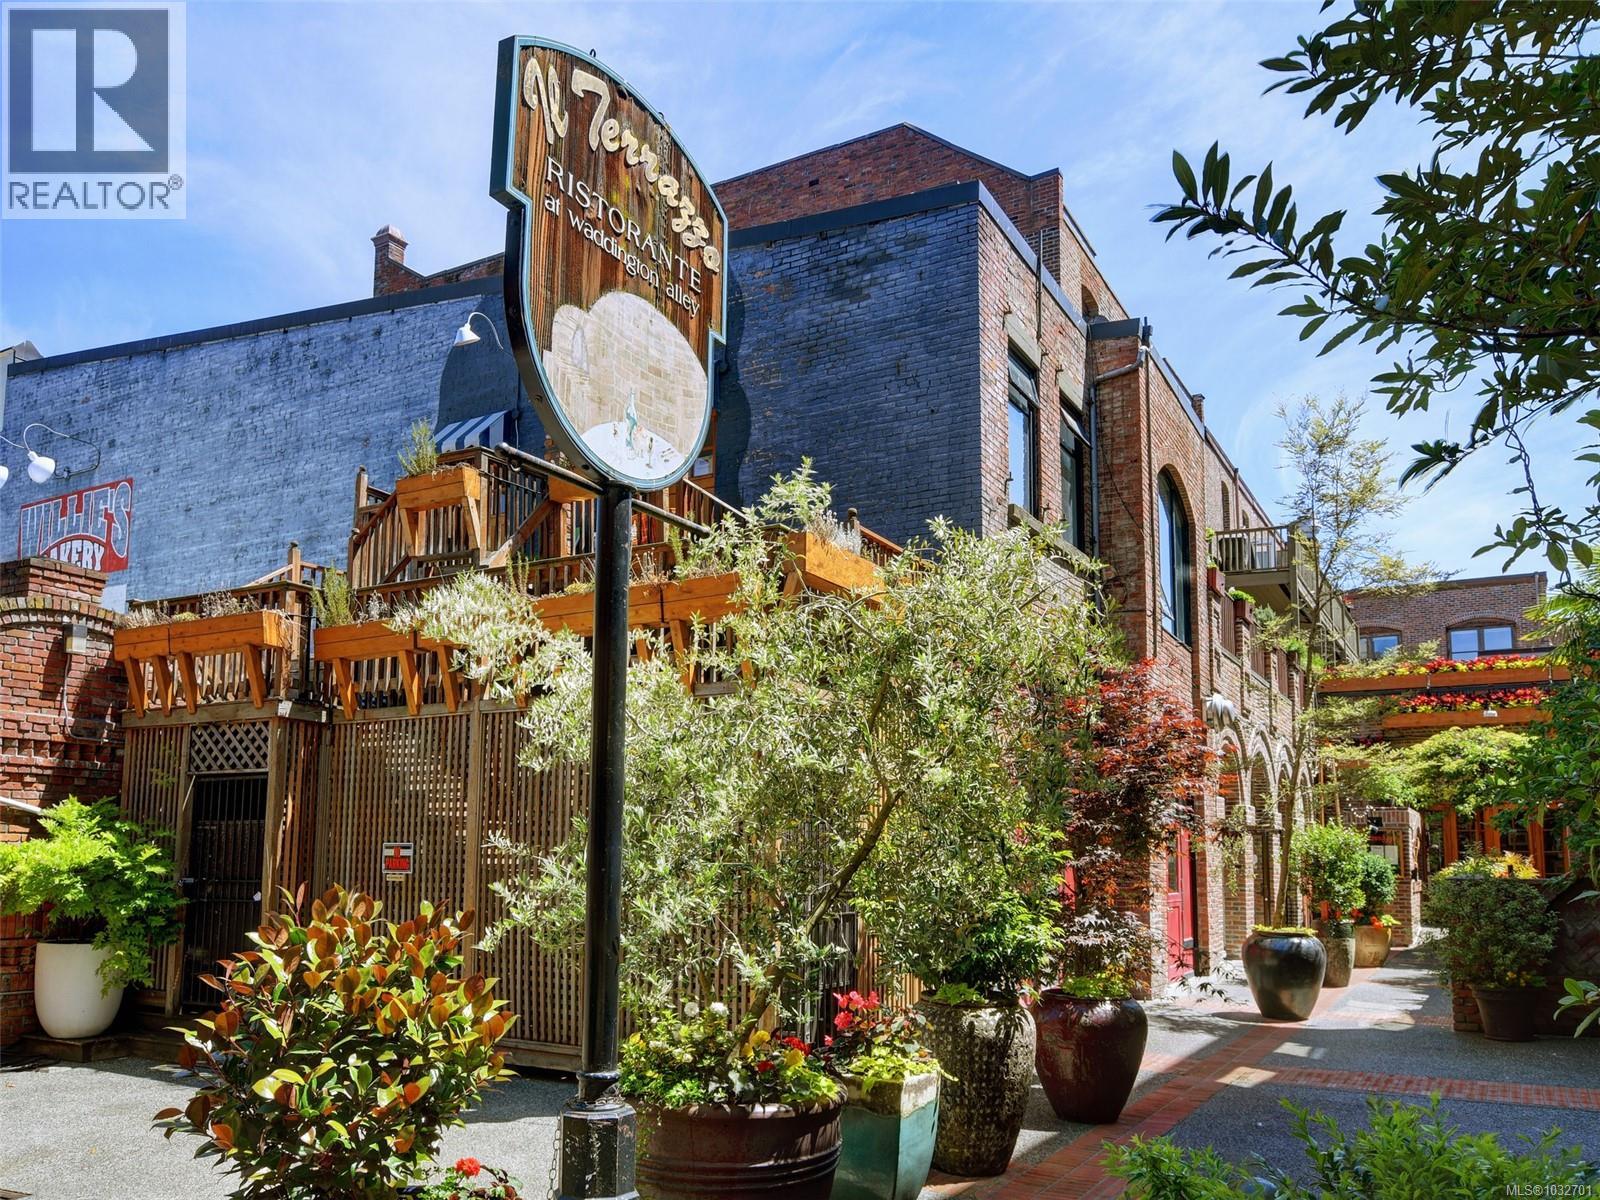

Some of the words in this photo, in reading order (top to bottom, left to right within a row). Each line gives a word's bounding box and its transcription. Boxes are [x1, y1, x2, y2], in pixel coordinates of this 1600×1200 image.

[546, 155, 702, 294] RISTORANTE
[571, 68, 721, 273] Terrazzo
[543, 193, 561, 217] at
[567, 207, 659, 289] waddington
[665, 281, 701, 318] alley
[20, 481, 132, 560] WILLIE'S
[49, 538, 105, 571] AKERY
